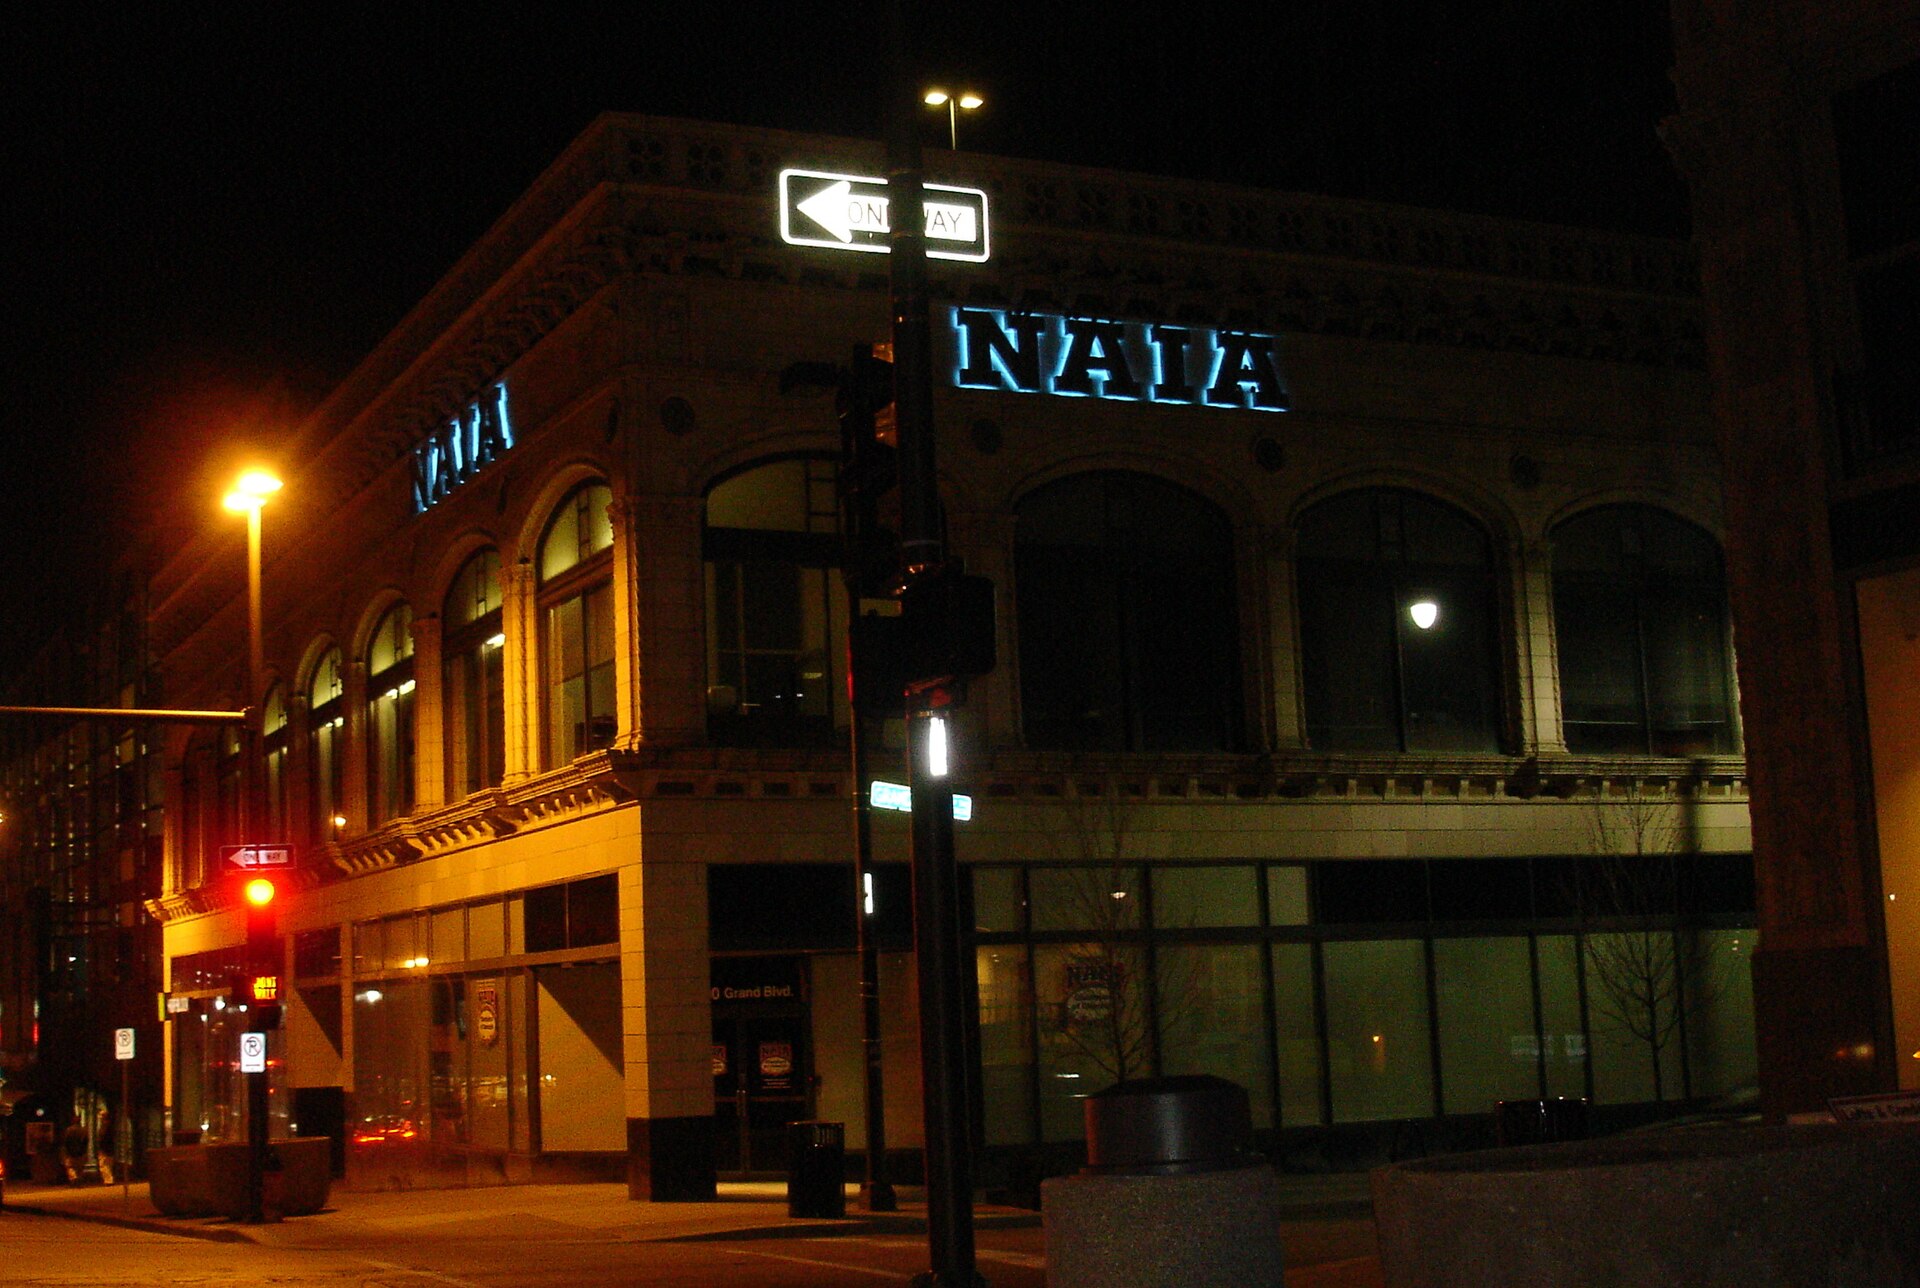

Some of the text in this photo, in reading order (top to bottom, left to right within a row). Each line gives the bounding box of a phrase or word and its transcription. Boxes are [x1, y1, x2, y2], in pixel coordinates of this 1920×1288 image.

[849, 201, 883, 227] ON
[949, 306, 1291, 413] NAIA
[413, 380, 515, 514] NAIA
[724, 986, 761, 999] Grand
[764, 985, 794, 998] Blvd.
